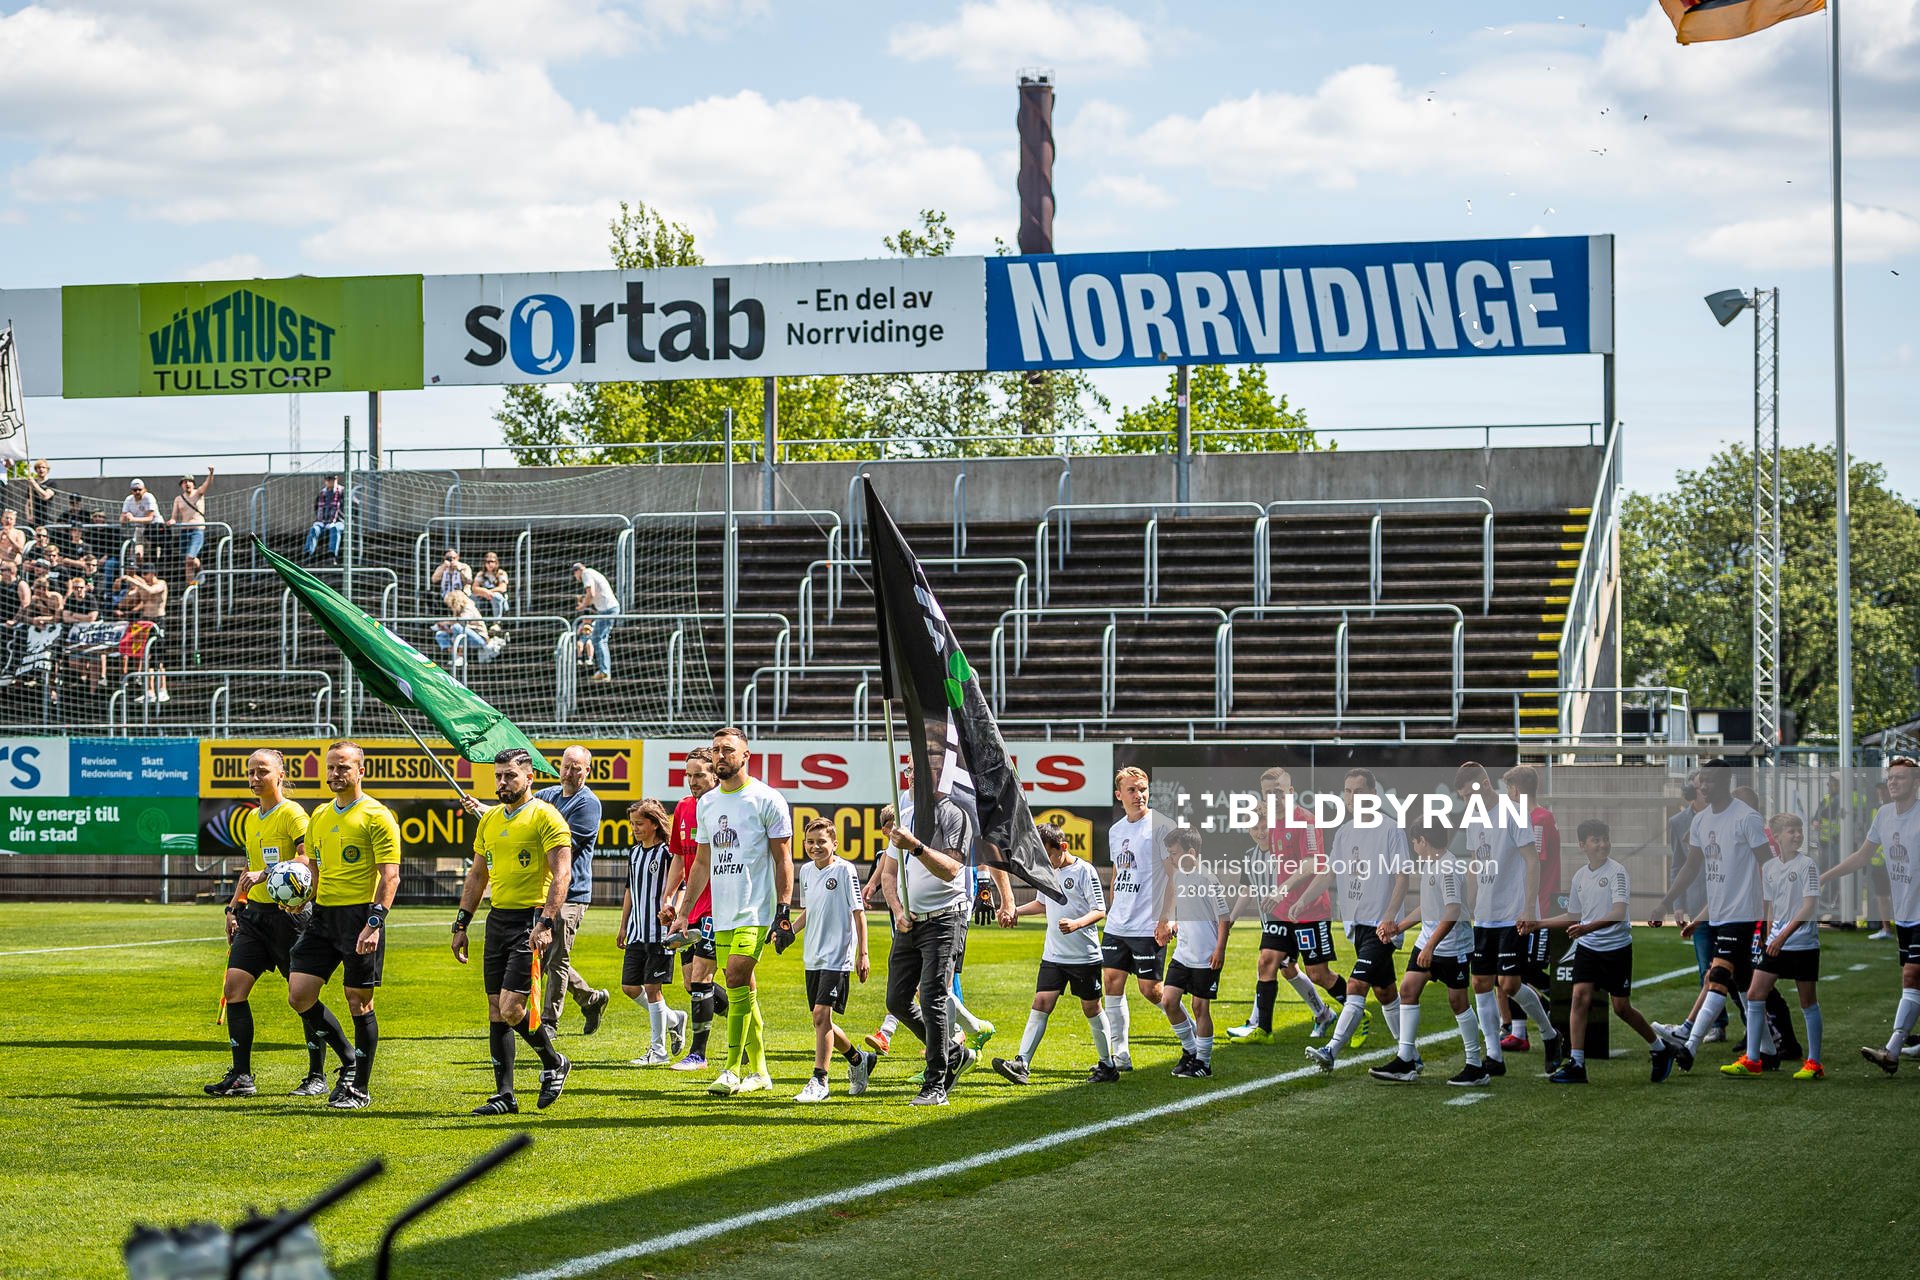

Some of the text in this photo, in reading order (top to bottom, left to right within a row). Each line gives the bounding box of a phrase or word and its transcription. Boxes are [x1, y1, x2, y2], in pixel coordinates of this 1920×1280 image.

[816, 289, 848, 311] En
[856, 286, 895, 311] del
[902, 291, 933, 309] av
[1008, 259, 1567, 362] NORRVIDINGE
[149, 288, 336, 365] VÄXTHUSET
[464, 278, 766, 375] sortab
[787, 319, 944, 348] Norrvidinge
[153, 367, 332, 391] TULLSTORP
[81, 757, 117, 766] Revision
[141, 757, 164, 766] Skatt
[81, 769, 133, 780] Redovisning
[141, 768, 188, 781] Rådgivning
[9, 806, 120, 825] Ny energi till
[9, 827, 78, 842] din stad
[718, 850, 733, 863] VÅR
[713, 863, 744, 875] KAPTEN
